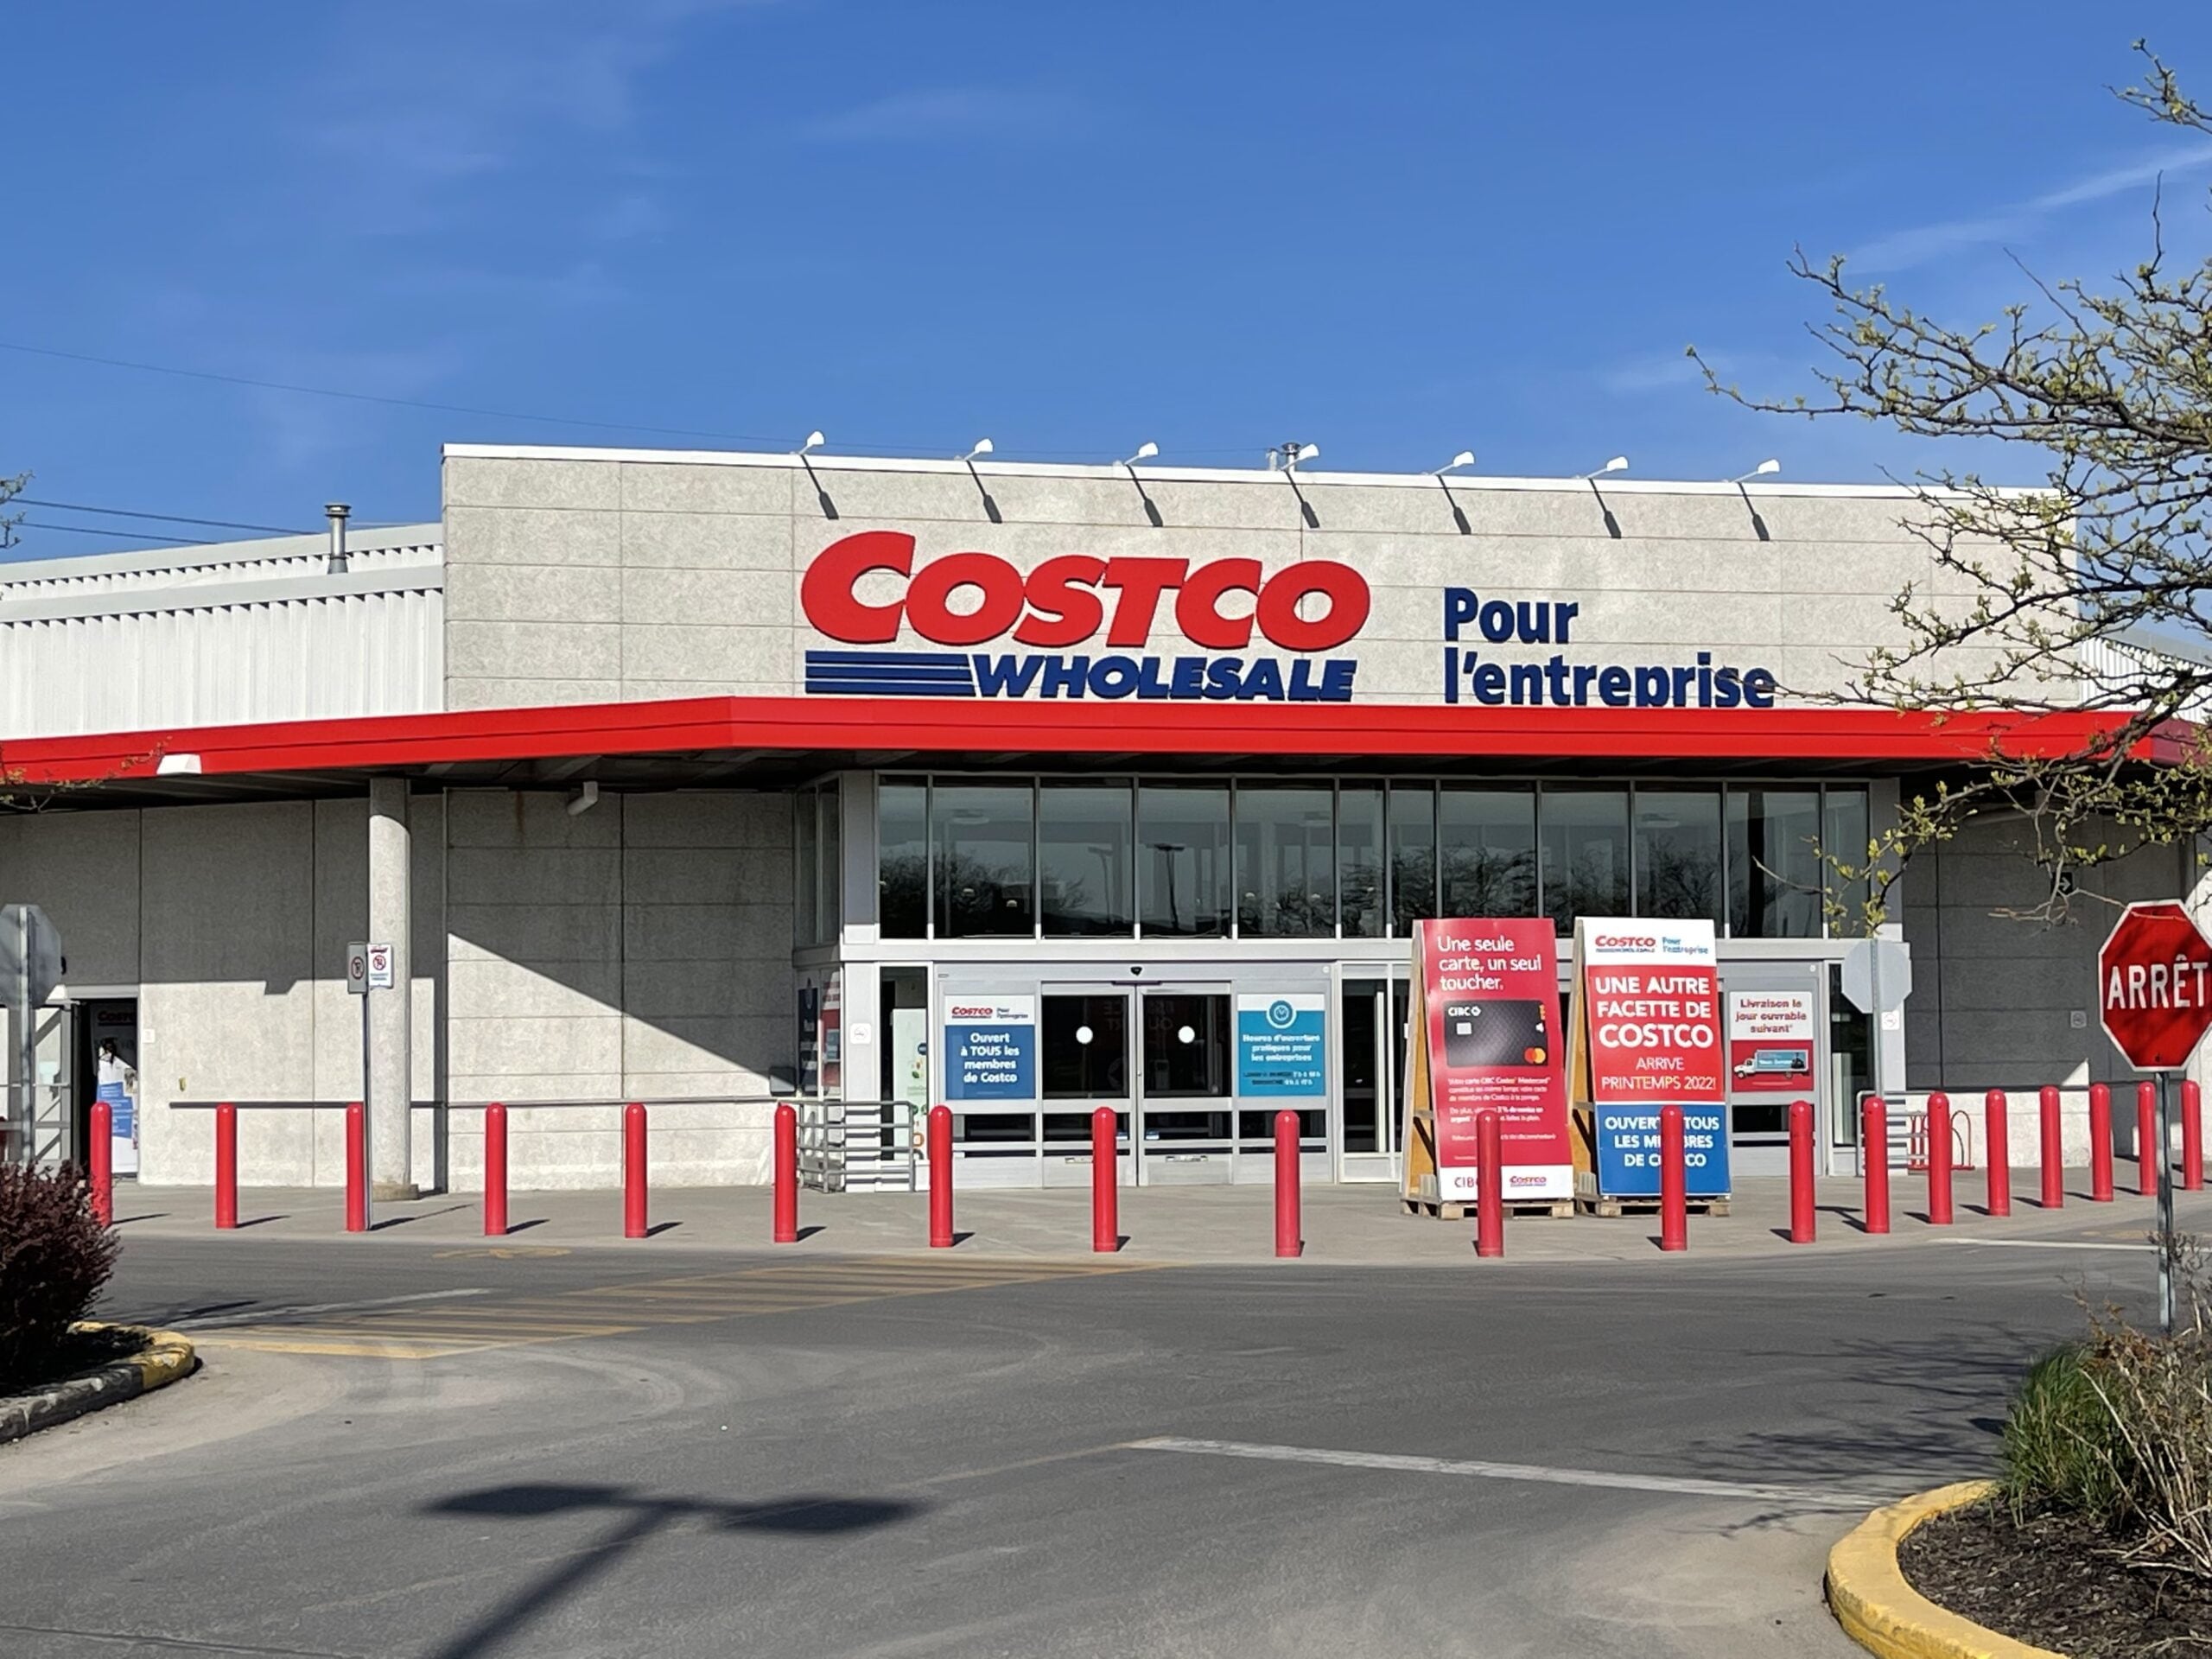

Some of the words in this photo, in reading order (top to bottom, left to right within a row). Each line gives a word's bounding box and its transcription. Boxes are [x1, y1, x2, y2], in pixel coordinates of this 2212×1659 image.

[800, 531, 1371, 652] COSTCO
[1444, 587, 1579, 645] Pour
[971, 654, 1357, 702] WHOLESALE
[1444, 646, 1777, 709] l'entreprise
[1438, 936, 1471, 952] Une
[1474, 936, 1515, 952] seule
[1595, 935, 1656, 947] COSTCO
[1439, 956, 1484, 972] carte,
[1488, 958, 1507, 971] un
[1510, 954, 1542, 971] seul
[1440, 974, 1503, 990] toucher.
[1595, 976, 1641, 995] UNE
[1646, 976, 1711, 995] AUTRE
[2107, 954, 2209, 1009] ARRÊT
[1597, 1000, 1681, 1018] FACETTE
[1685, 1001, 1712, 1019] DE
[1739, 999, 1789, 1008] Livraison
[1792, 999, 1802, 1008] le
[951, 1007, 994, 1015] COSTCO
[1735, 1011, 1758, 1022] jour
[1760, 1011, 1808, 1020] ouvrable
[969, 1033, 1010, 1043] Ouvert
[1599, 1022, 1714, 1048] COSTCO
[969, 1046, 1001, 1056] TOUS
[1004, 1045, 1020, 1056] les
[963, 1058, 1017, 1070] membres
[1636, 1057, 1684, 1071] ARRIVE
[963, 1071, 978, 1083] de
[981, 1071, 1018, 1083] Costco
[1601, 1076, 1681, 1090] PRINTEMPS
[1684, 1116, 1720, 1130] TOUS
[1614, 1135, 1640, 1148] LES
[1624, 1154, 1644, 1166] DE
[1649, 1154, 1707, 1167] CCO
[1454, 1176, 1478, 1188] CIB
